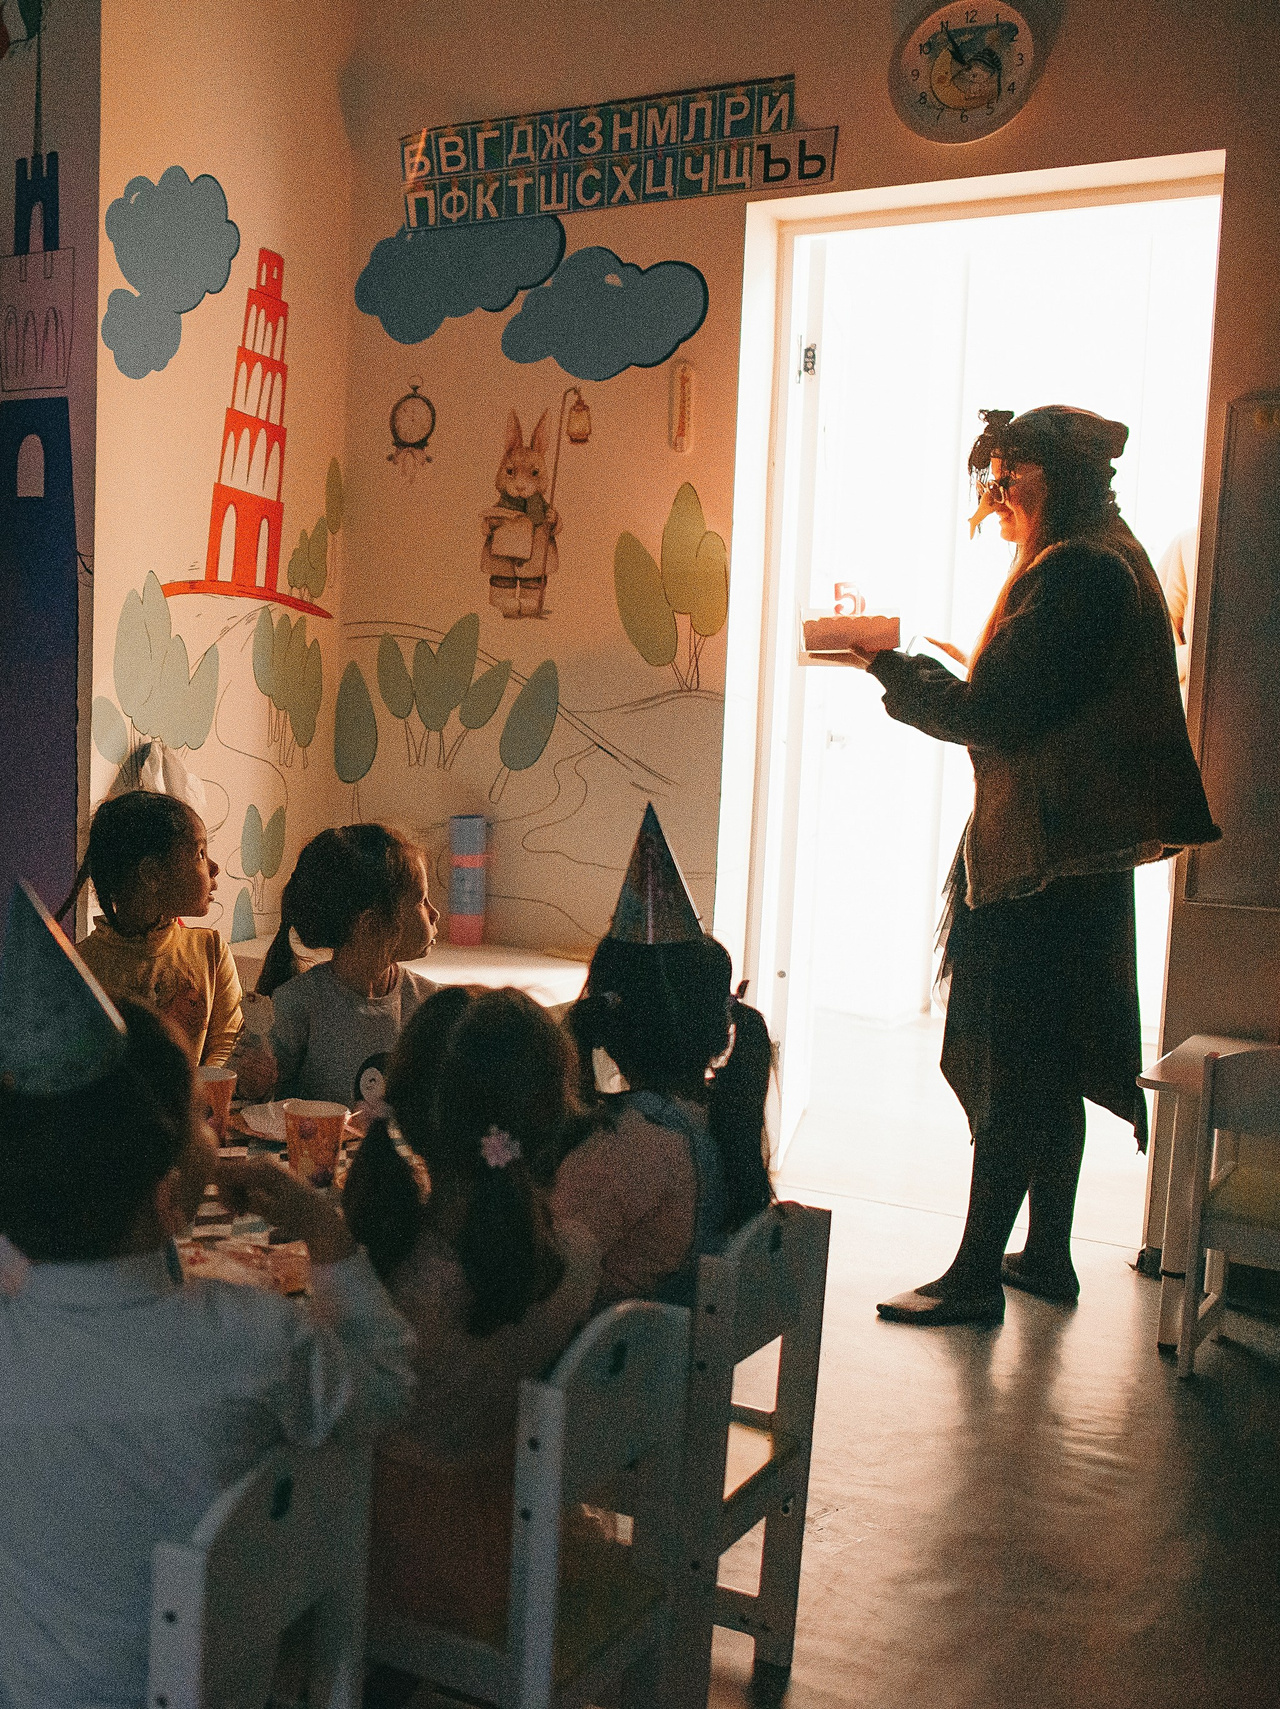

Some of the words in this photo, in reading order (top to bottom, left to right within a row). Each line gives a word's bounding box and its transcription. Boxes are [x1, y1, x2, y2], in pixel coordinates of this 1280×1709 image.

[965, 9, 977, 23] 12
[919, 42, 931, 55] 10
[1016, 53, 1024, 67] 3
[911, 69, 920, 81] 9
[1007, 82, 1017, 94] 4
[918, 91, 927, 105] 8
[936, 106, 945, 122] 7
[986, 101, 995, 115] 5
[960, 109, 969, 123] 6
[834, 582, 866, 616] 5
